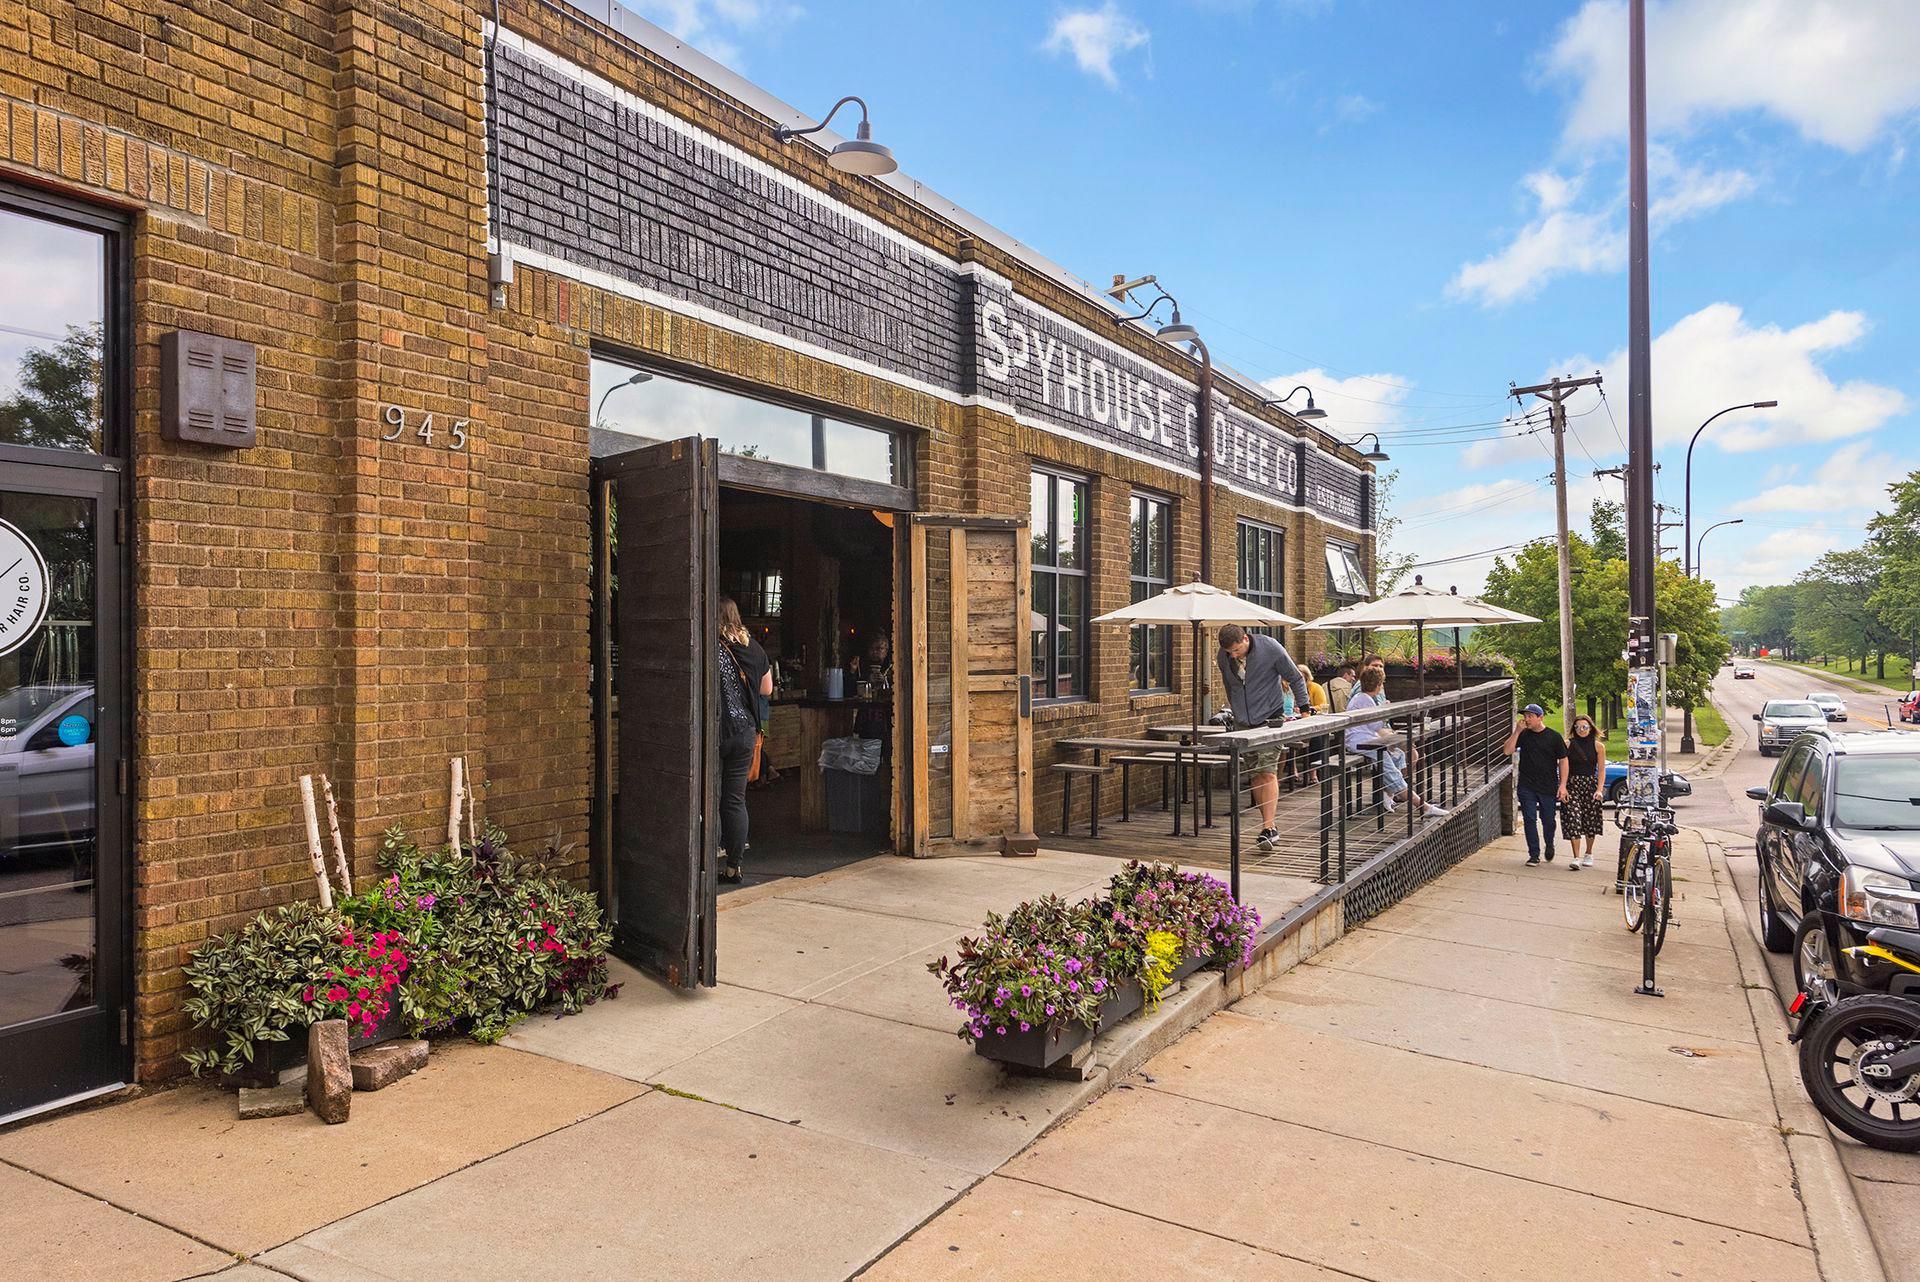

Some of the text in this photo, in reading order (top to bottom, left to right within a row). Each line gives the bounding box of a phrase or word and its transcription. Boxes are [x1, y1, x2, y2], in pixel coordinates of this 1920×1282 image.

[382, 405, 470, 449] 945
[6, 596, 29, 625] HAIR
[18, 571, 31, 592] CO.
